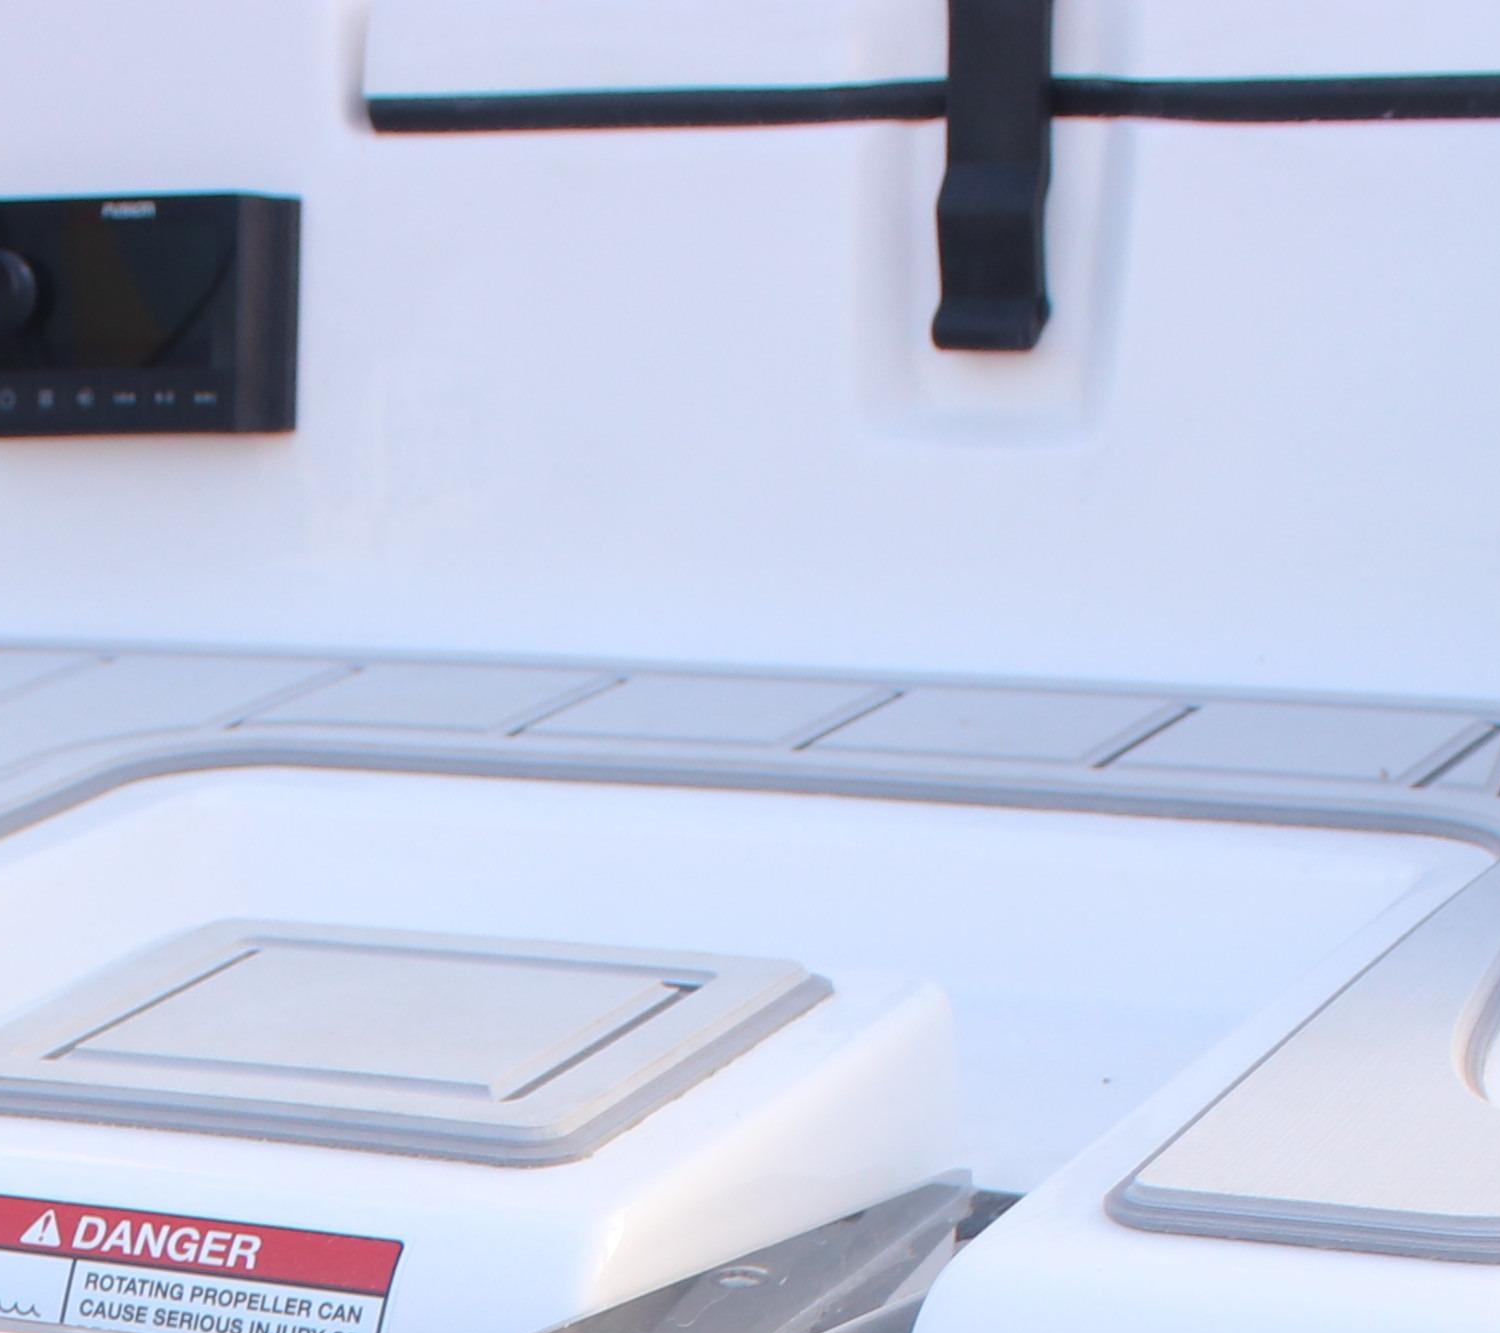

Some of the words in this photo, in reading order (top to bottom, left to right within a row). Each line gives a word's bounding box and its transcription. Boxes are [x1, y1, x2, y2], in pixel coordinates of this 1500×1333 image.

[72, 1214, 263, 1271] DANGER
[78, 1298, 149, 1324] CAUSE
[83, 1272, 186, 1302] ROTATING
[188, 1284, 314, 1316] PROPELLER
[317, 1300, 364, 1325] CAN
